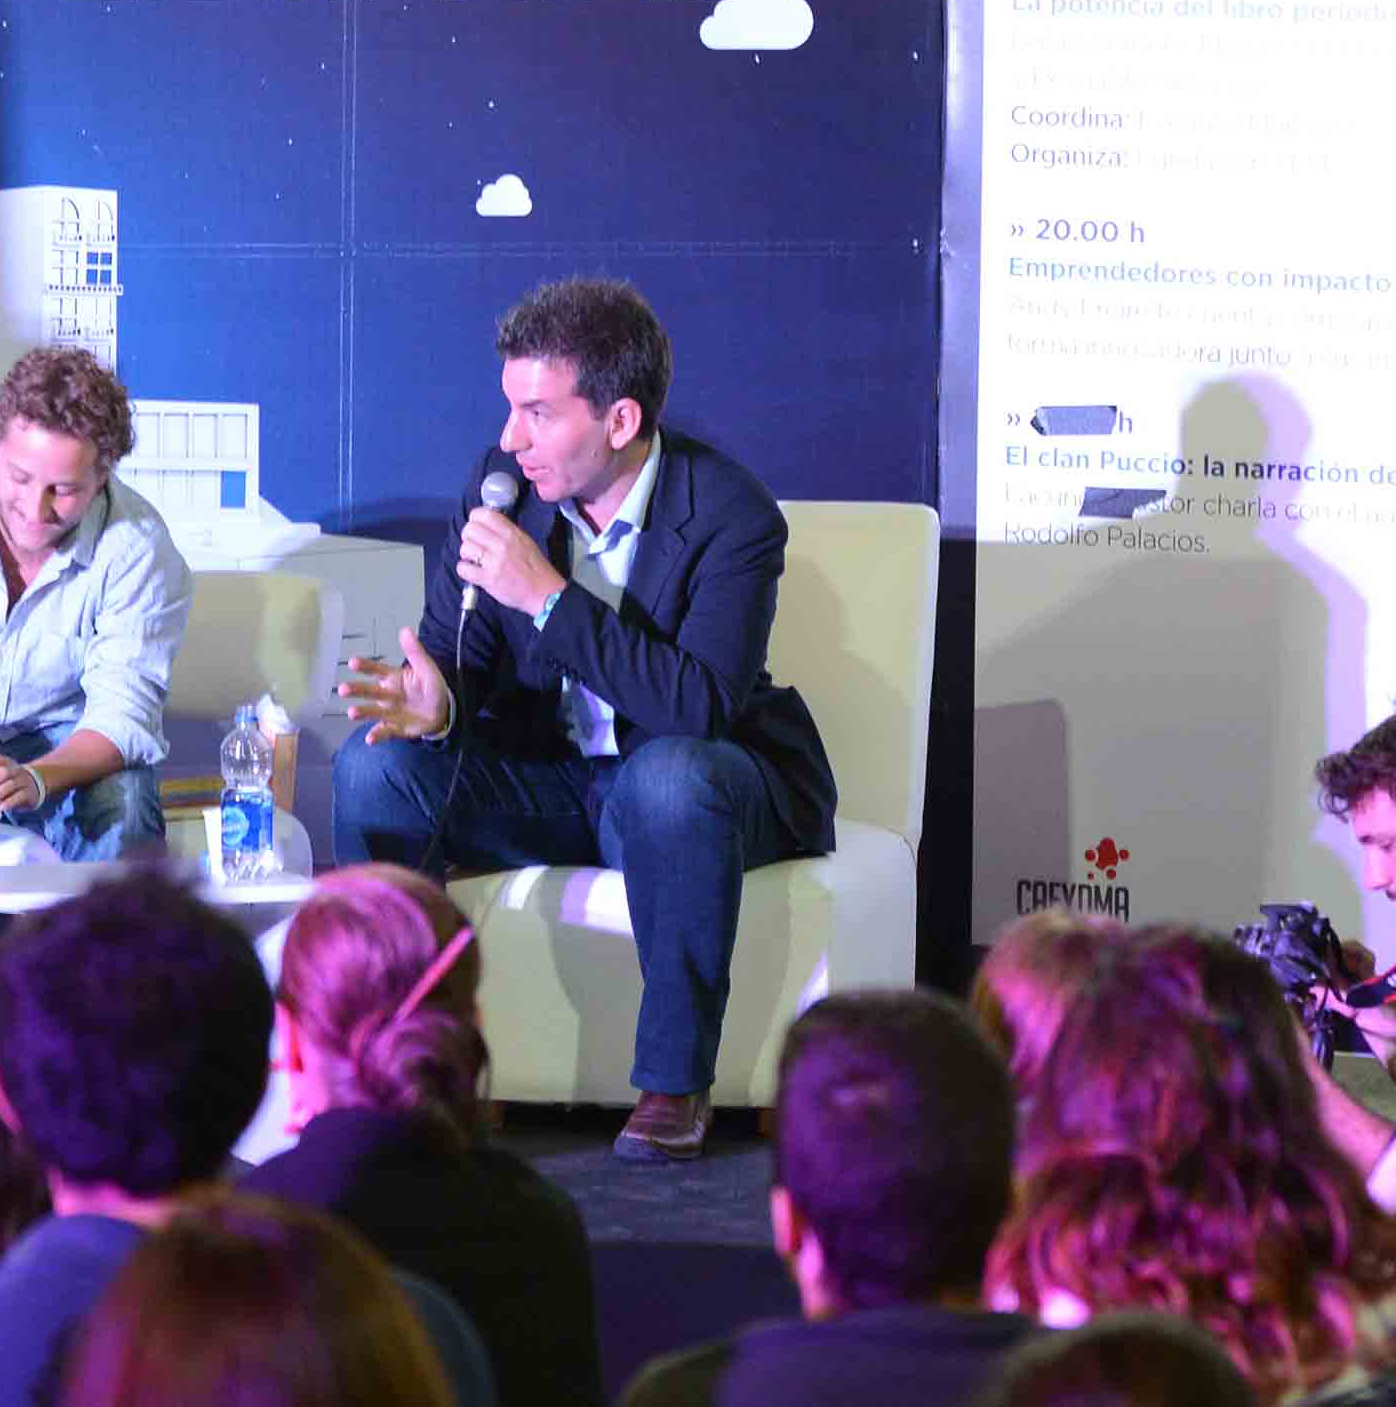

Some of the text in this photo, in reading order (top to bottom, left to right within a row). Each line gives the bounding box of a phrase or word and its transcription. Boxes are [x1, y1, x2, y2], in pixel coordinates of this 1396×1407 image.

[1035, 218, 1119, 242] 20.00
[1130, 220, 1146, 244] h
[1008, 256, 1217, 286] Emprendedores
[1226, 269, 1274, 289] con
[1283, 267, 1392, 296] impacto
[1005, 445, 1026, 466] El
[1038, 447, 1090, 470] clan
[1100, 450, 1194, 474] Puccio:
[1203, 454, 1224, 477] la
[1235, 458, 1359, 485] narración
[1203, 492, 1277, 520] charla
[1107, 526, 1211, 554] Palacios.
